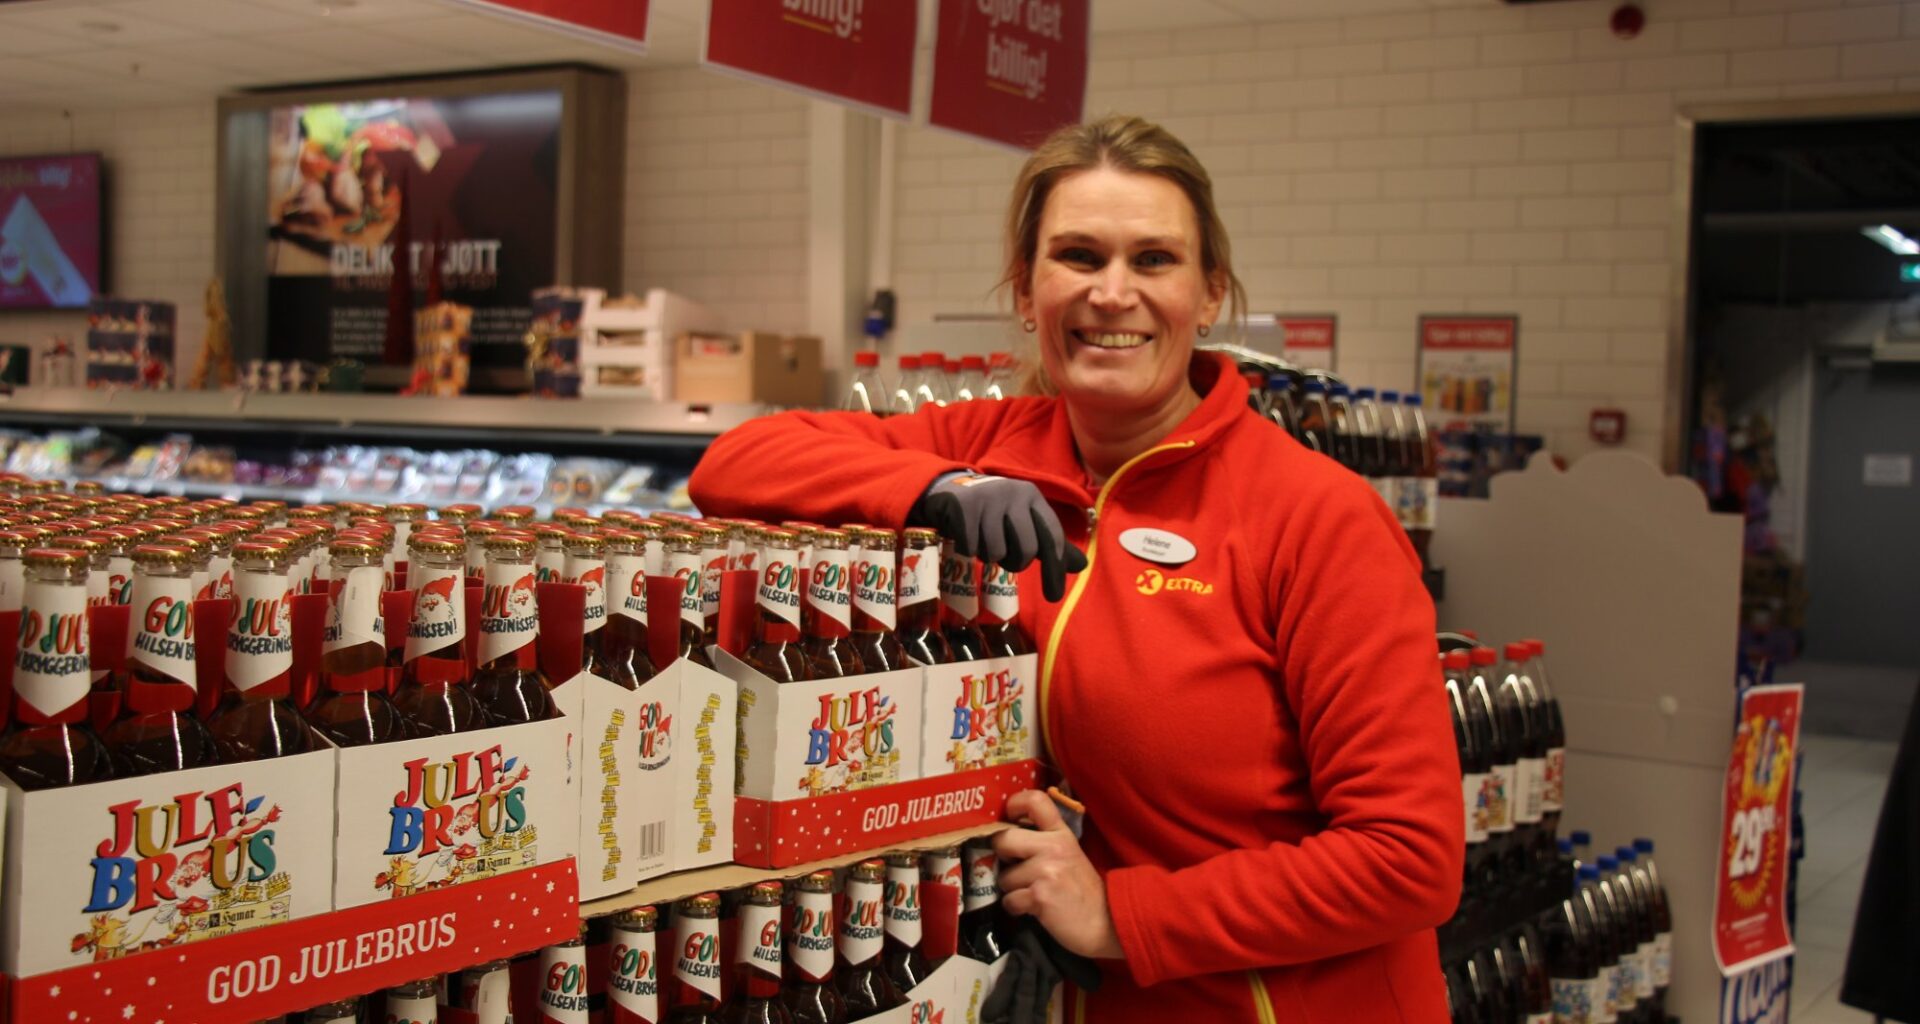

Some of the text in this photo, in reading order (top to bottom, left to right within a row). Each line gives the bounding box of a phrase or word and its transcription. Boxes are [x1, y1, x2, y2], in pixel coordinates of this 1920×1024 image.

[986, 33, 1047, 98] billig!
[332, 239, 501, 276] DELIKT JØTT
[765, 561, 799, 592] GOD
[813, 560, 847, 590] GOD
[858, 561, 888, 589] GOD
[1166, 578, 1213, 594] EXTRA
[40, 612, 85, 655] JUL
[238, 598, 281, 636] JUL
[135, 632, 183, 660] HILSEN
[957, 669, 1011, 710] JULE
[640, 701, 662, 731] GOD
[812, 686, 882, 732] JULE
[393, 744, 503, 808] JULE
[96, 782, 246, 858] JULE
[862, 786, 986, 832] GOD JULEBRUS
[850, 900, 878, 926] JUL
[207, 912, 457, 1004] GOD JULEBRUS
[612, 943, 649, 979] GOD
[685, 931, 719, 963] GOD
[547, 961, 585, 995] GOD
